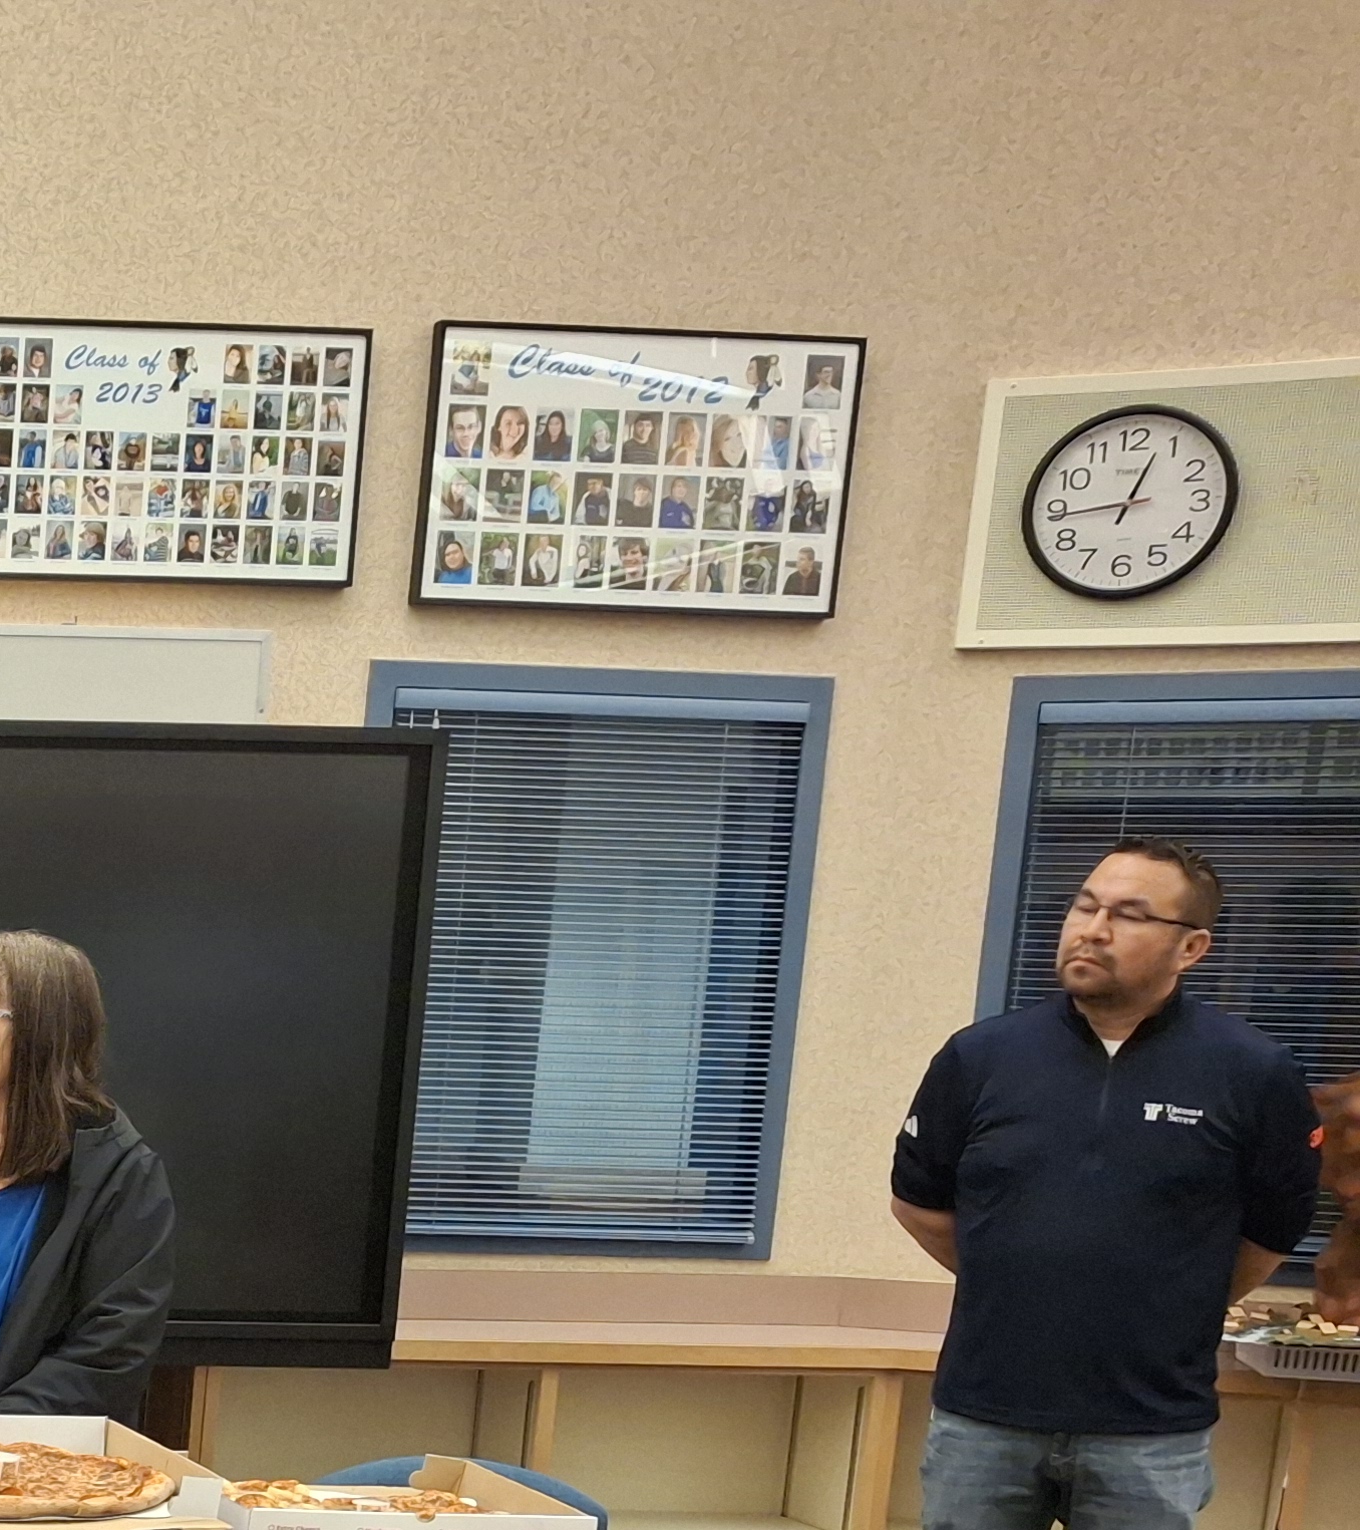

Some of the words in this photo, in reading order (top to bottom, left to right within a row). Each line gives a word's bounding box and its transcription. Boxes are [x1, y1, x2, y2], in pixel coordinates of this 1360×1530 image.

[64, 344, 129, 370] Class
[138, 349, 162, 378] of
[508, 343, 596, 378] Class
[608, 351, 641, 387] of
[95, 381, 163, 404] 2013
[638, 375, 729, 404] 2012
[1119, 427, 1151, 452] 12
[1168, 435, 1178, 458] 1
[1087, 441, 1108, 463] 11
[1059, 467, 1091, 490] 10
[1183, 460, 1206, 482] 2
[1047, 498, 1068, 522] 9
[1189, 489, 1211, 512] 3
[1056, 528, 1076, 551] 8
[1172, 521, 1195, 543] 4
[1078, 548, 1098, 569] 7
[1111, 554, 1132, 577] 6
[1147, 544, 1168, 567] 5
[1165, 1103, 1204, 1118] Tacoma
[1167, 1113, 1199, 1126] Screw
